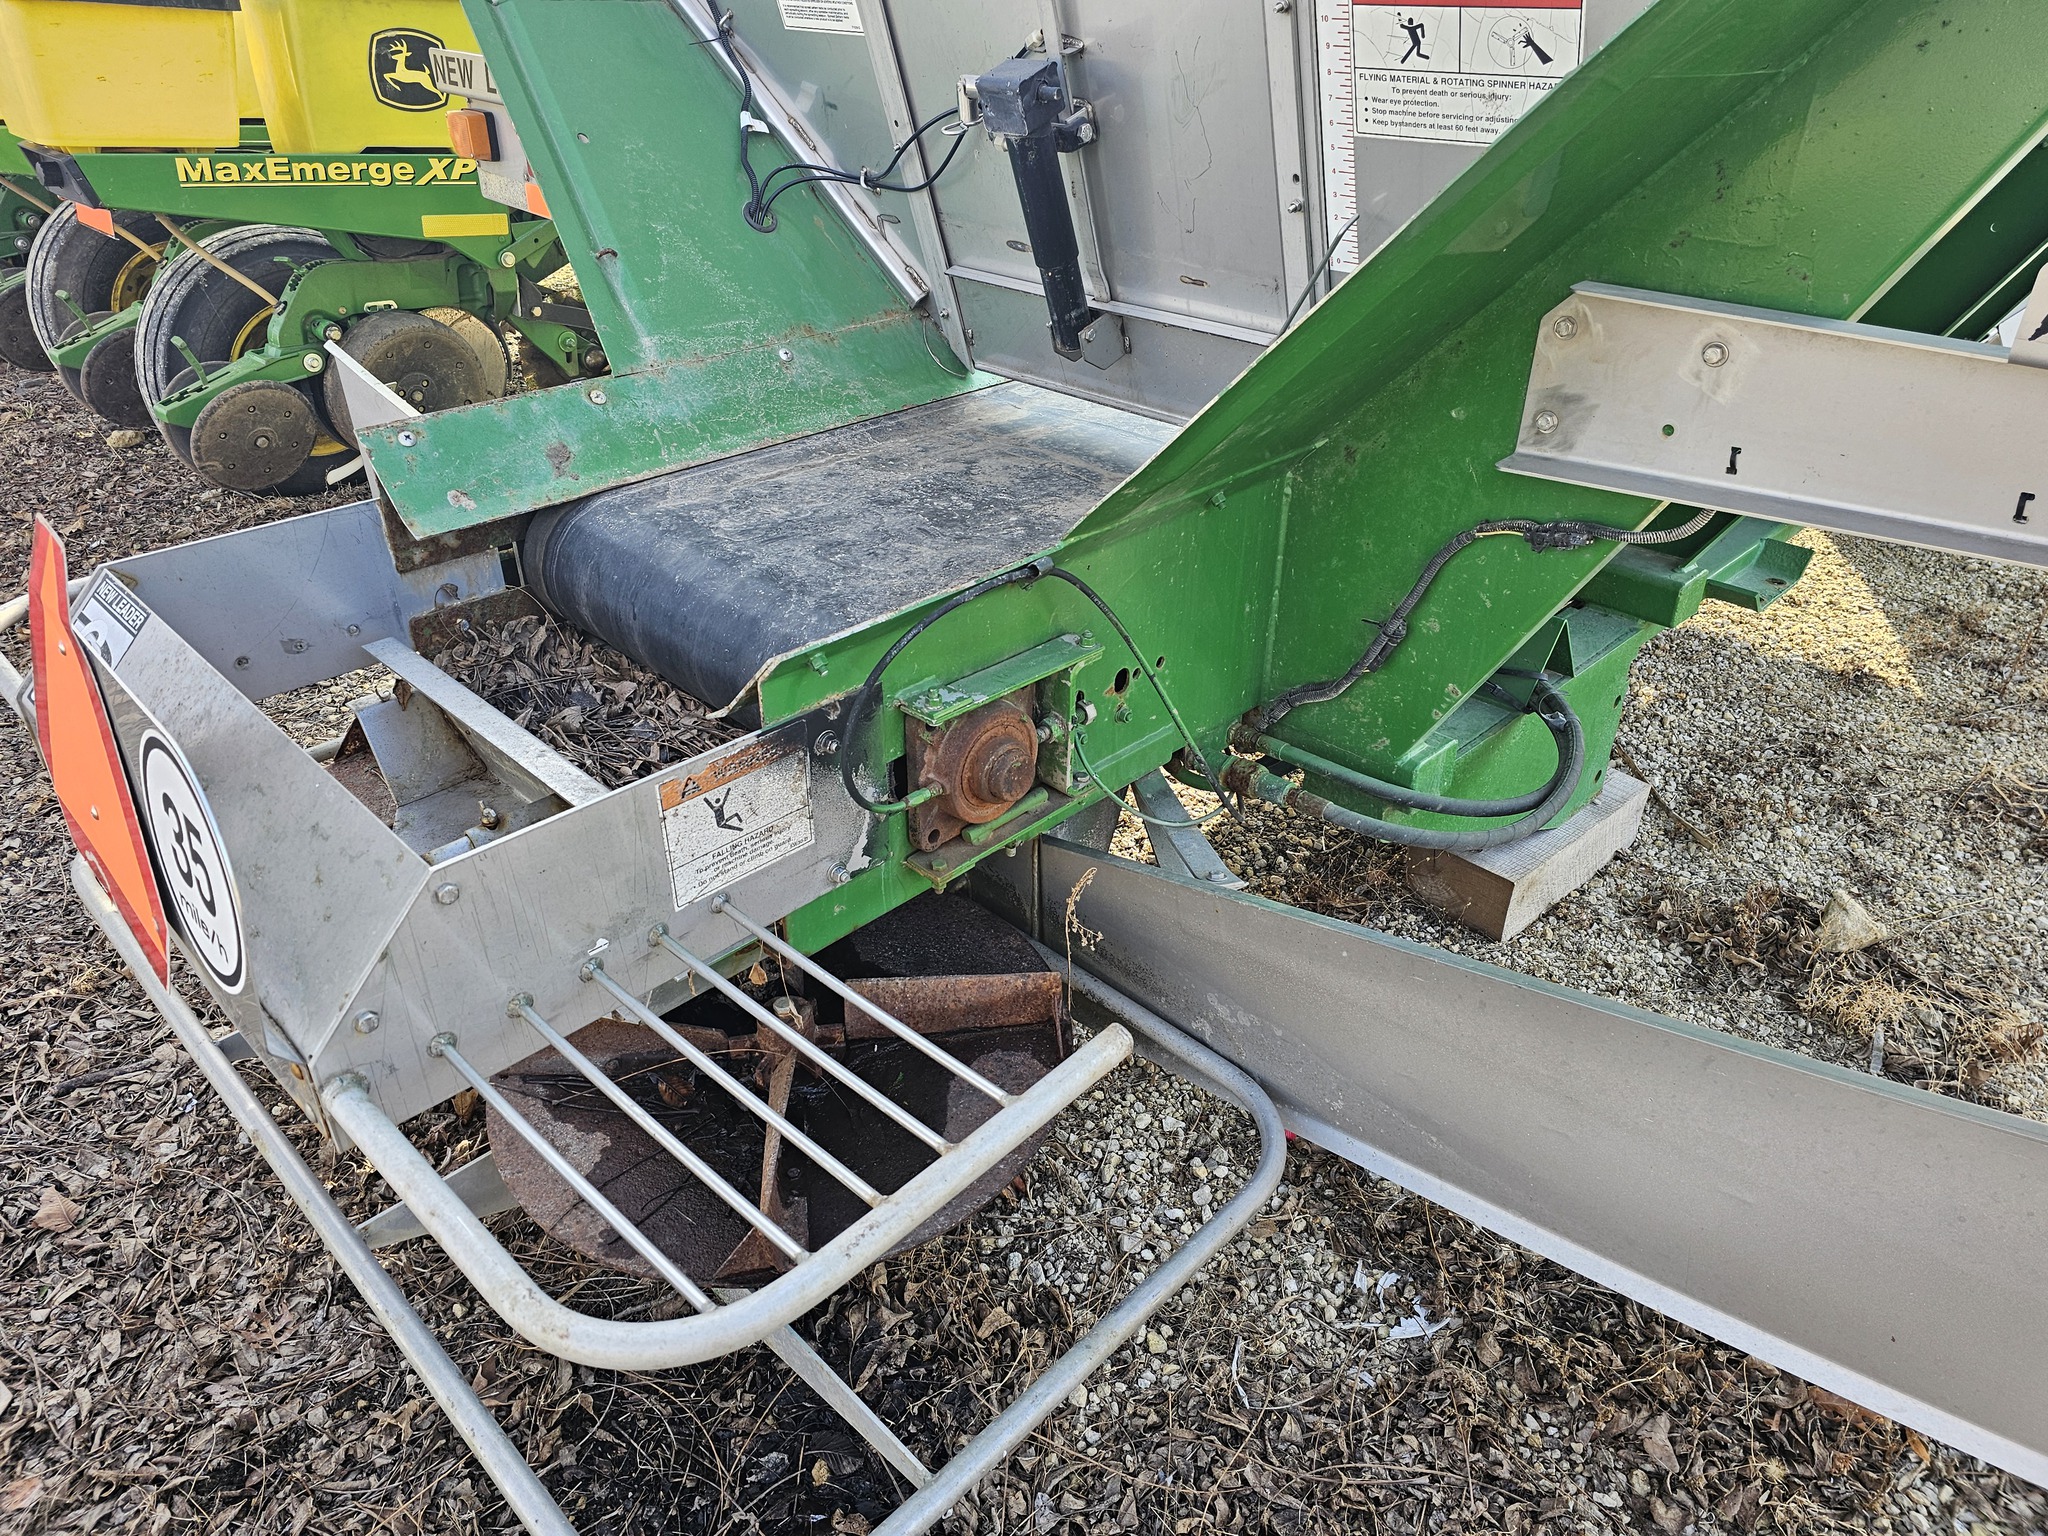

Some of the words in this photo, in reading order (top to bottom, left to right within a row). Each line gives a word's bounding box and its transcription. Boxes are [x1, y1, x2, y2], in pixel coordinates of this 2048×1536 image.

[433, 54, 473, 90] NEW
[1359, 73, 1387, 82] FLYING
[1390, 74, 1430, 84] MATERIAL
[1432, 77, 1439, 85] &
[1441, 78, 1484, 87] ROTATING
[1487, 80, 1526, 89] SPINNER
[1371, 96, 1388, 104] Wear
[1389, 98, 1401, 106] eye
[1403, 99, 1439, 108] protection.
[1402, 88, 1428, 96] prevent
[1429, 88, 1449, 97] death
[1372, 107, 1387, 116] Stop
[1418, 111, 1440, 119] before
[1441, 113, 1474, 122] servicing
[1372, 118, 1389, 127] Keep
[1390, 119, 1427, 129] bystanders
[1437, 123, 1453, 131] least
[1480, 126, 1501, 135] away.
[174, 157, 416, 186] MaxEmerge
[415, 158, 478, 186] XP
[96, 580, 118, 604] NEW
[111, 596, 145, 630] LEADER
[162, 792, 216, 918] 35
[712, 840, 743, 860] FALLING
[744, 826, 774, 845] HAZARD
[178, 892, 229, 964] mile/h
